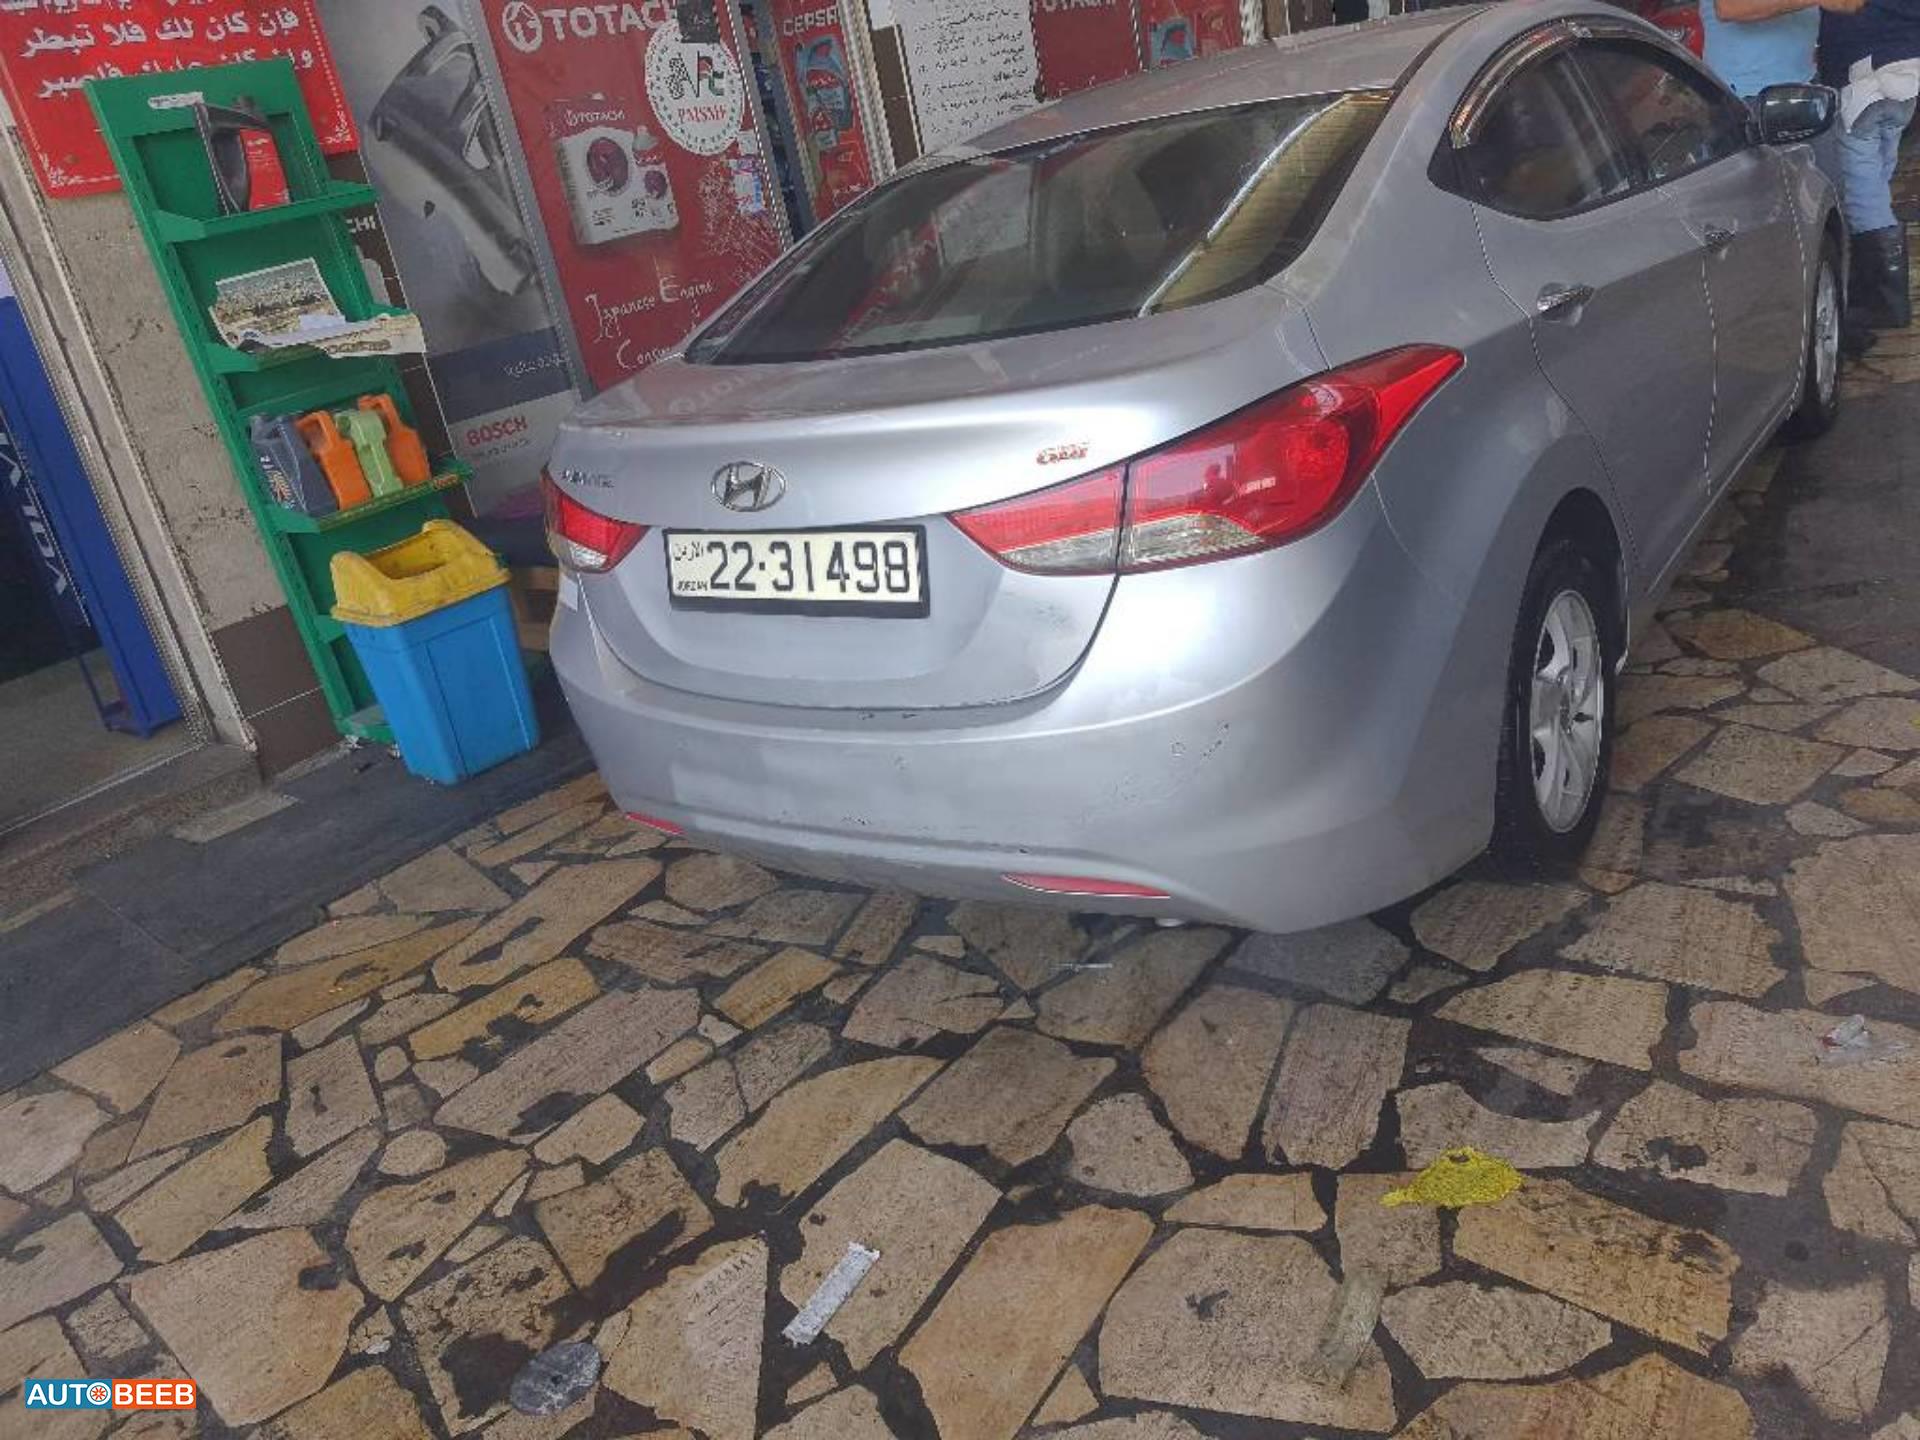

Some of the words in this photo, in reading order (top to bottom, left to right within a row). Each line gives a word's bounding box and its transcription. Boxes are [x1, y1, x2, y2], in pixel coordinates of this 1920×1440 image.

[102, 19, 147, 46] فلا
[155, 17, 194, 40] لك
[206, 10, 250, 42] كان
[783, 7, 838, 36] CEPSA
[466, 416, 528, 447] BOSCH
